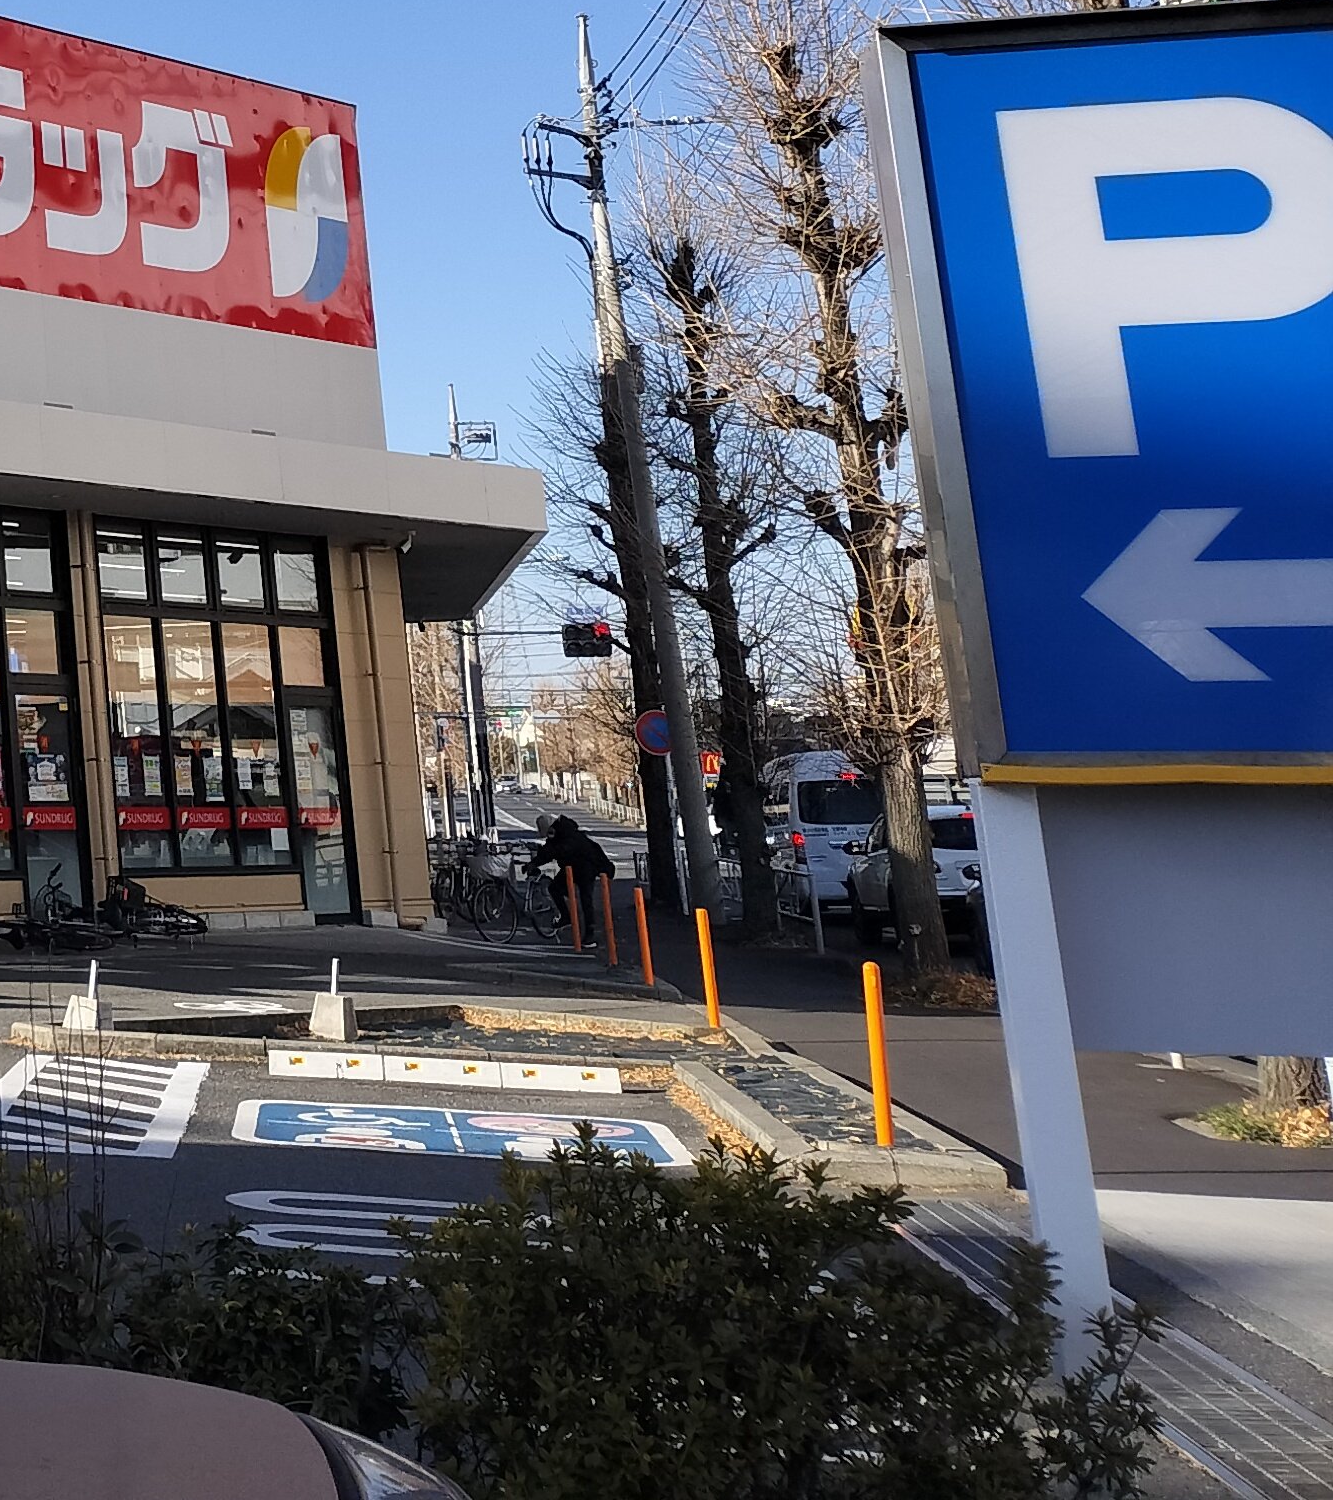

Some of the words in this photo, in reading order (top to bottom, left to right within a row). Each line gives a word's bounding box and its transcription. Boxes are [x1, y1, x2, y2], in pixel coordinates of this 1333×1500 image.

[994, 96, 1333, 458] P
[34, 812, 73, 824] SUNDRUG
[126, 812, 164, 824] SUNDRUG
[189, 812, 224, 824] SUNDRUG
[248, 812, 282, 824] SUNDRUG
